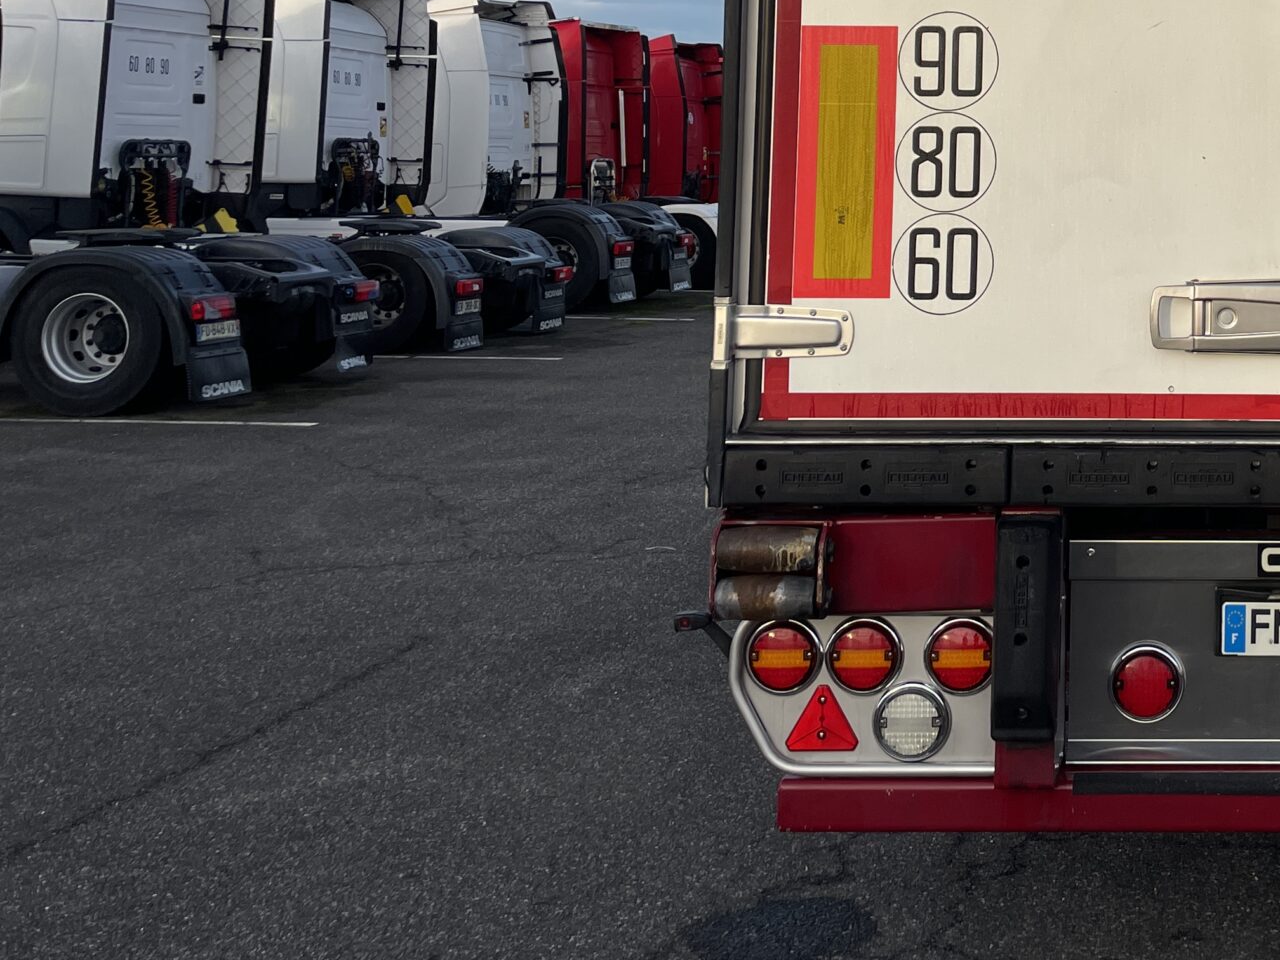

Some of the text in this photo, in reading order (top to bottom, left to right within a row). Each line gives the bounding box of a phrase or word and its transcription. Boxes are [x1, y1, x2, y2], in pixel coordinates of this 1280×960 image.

[128, 55, 170, 75] 60 80 90
[913, 25, 983, 97] 90
[911, 126, 981, 198] 80
[907, 227, 978, 300] 60
[340, 310, 369, 324] SCANIA
[201, 379, 245, 398] SCANIA
[1231, 632, 1239, 645] F
